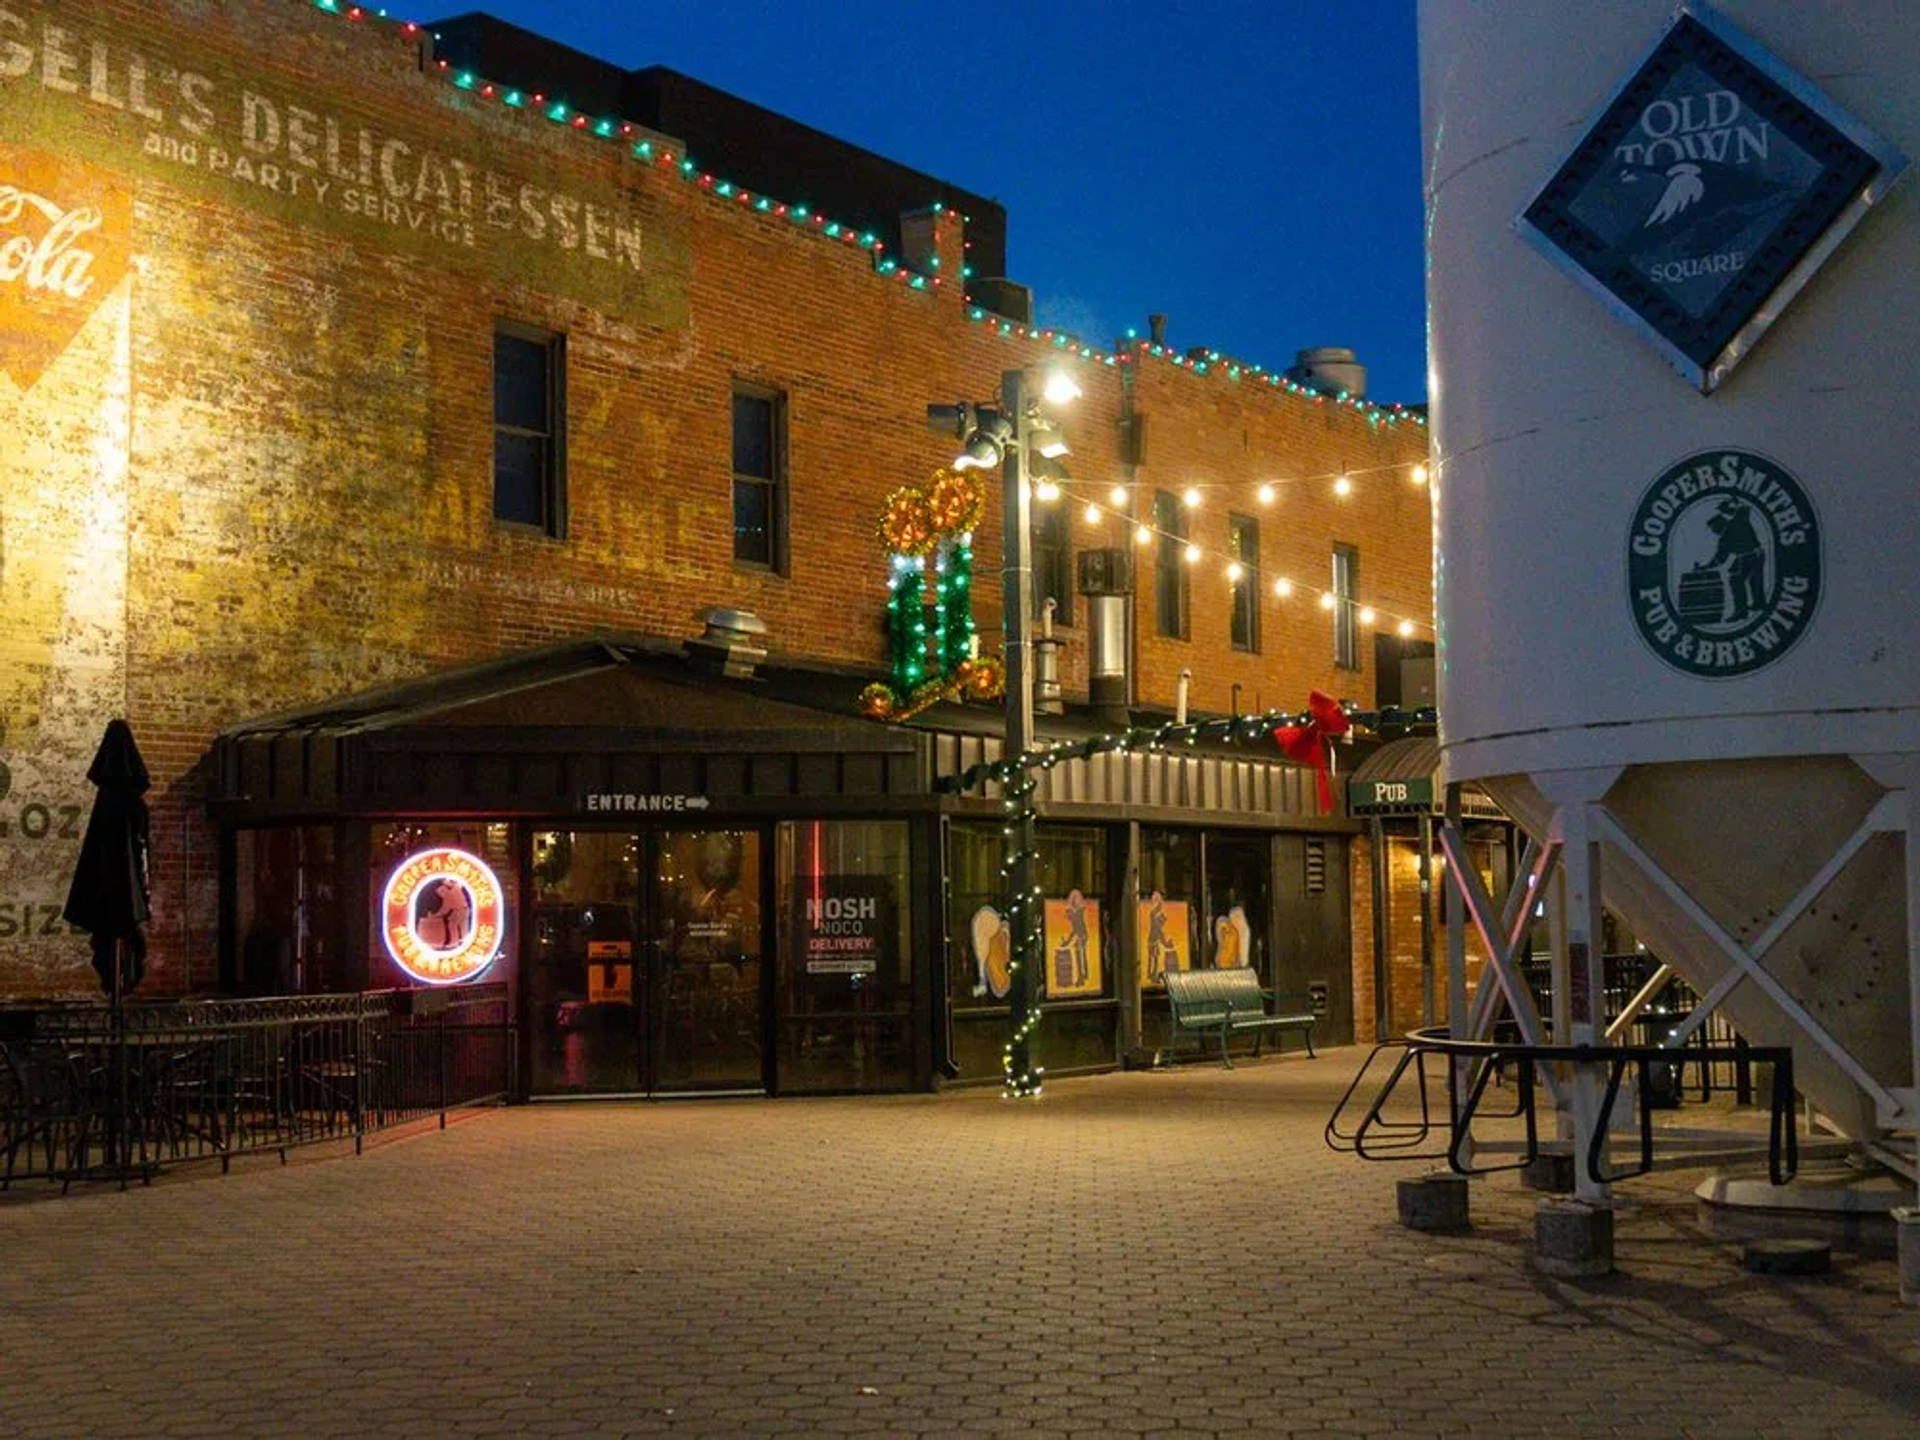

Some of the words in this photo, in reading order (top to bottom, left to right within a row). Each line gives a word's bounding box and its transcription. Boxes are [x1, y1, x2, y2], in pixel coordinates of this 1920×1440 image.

[1641, 90, 1739, 138] OLD
[1614, 121, 1770, 166] TOWN
[143, 131, 200, 166] and
[207, 146, 330, 202] PARTY
[343, 189, 475, 247] SERVICE
[241, 89, 643, 271] DELICATESSEN
[1651, 252, 1744, 283] SQUARE
[1633, 456, 1811, 556] COOPERSMITH'S
[1640, 586, 1678, 643] PUB
[1674, 633, 1694, 659] &
[1695, 576, 1809, 667] BREWING
[587, 794, 685, 811] ENTRANCE
[1374, 781, 1408, 802] PUB
[0, 903, 92, 937] SIZ
[806, 898, 876, 919] NOSH
[809, 937, 874, 950] DELIVERY
[820, 920, 864, 935] NOCO
